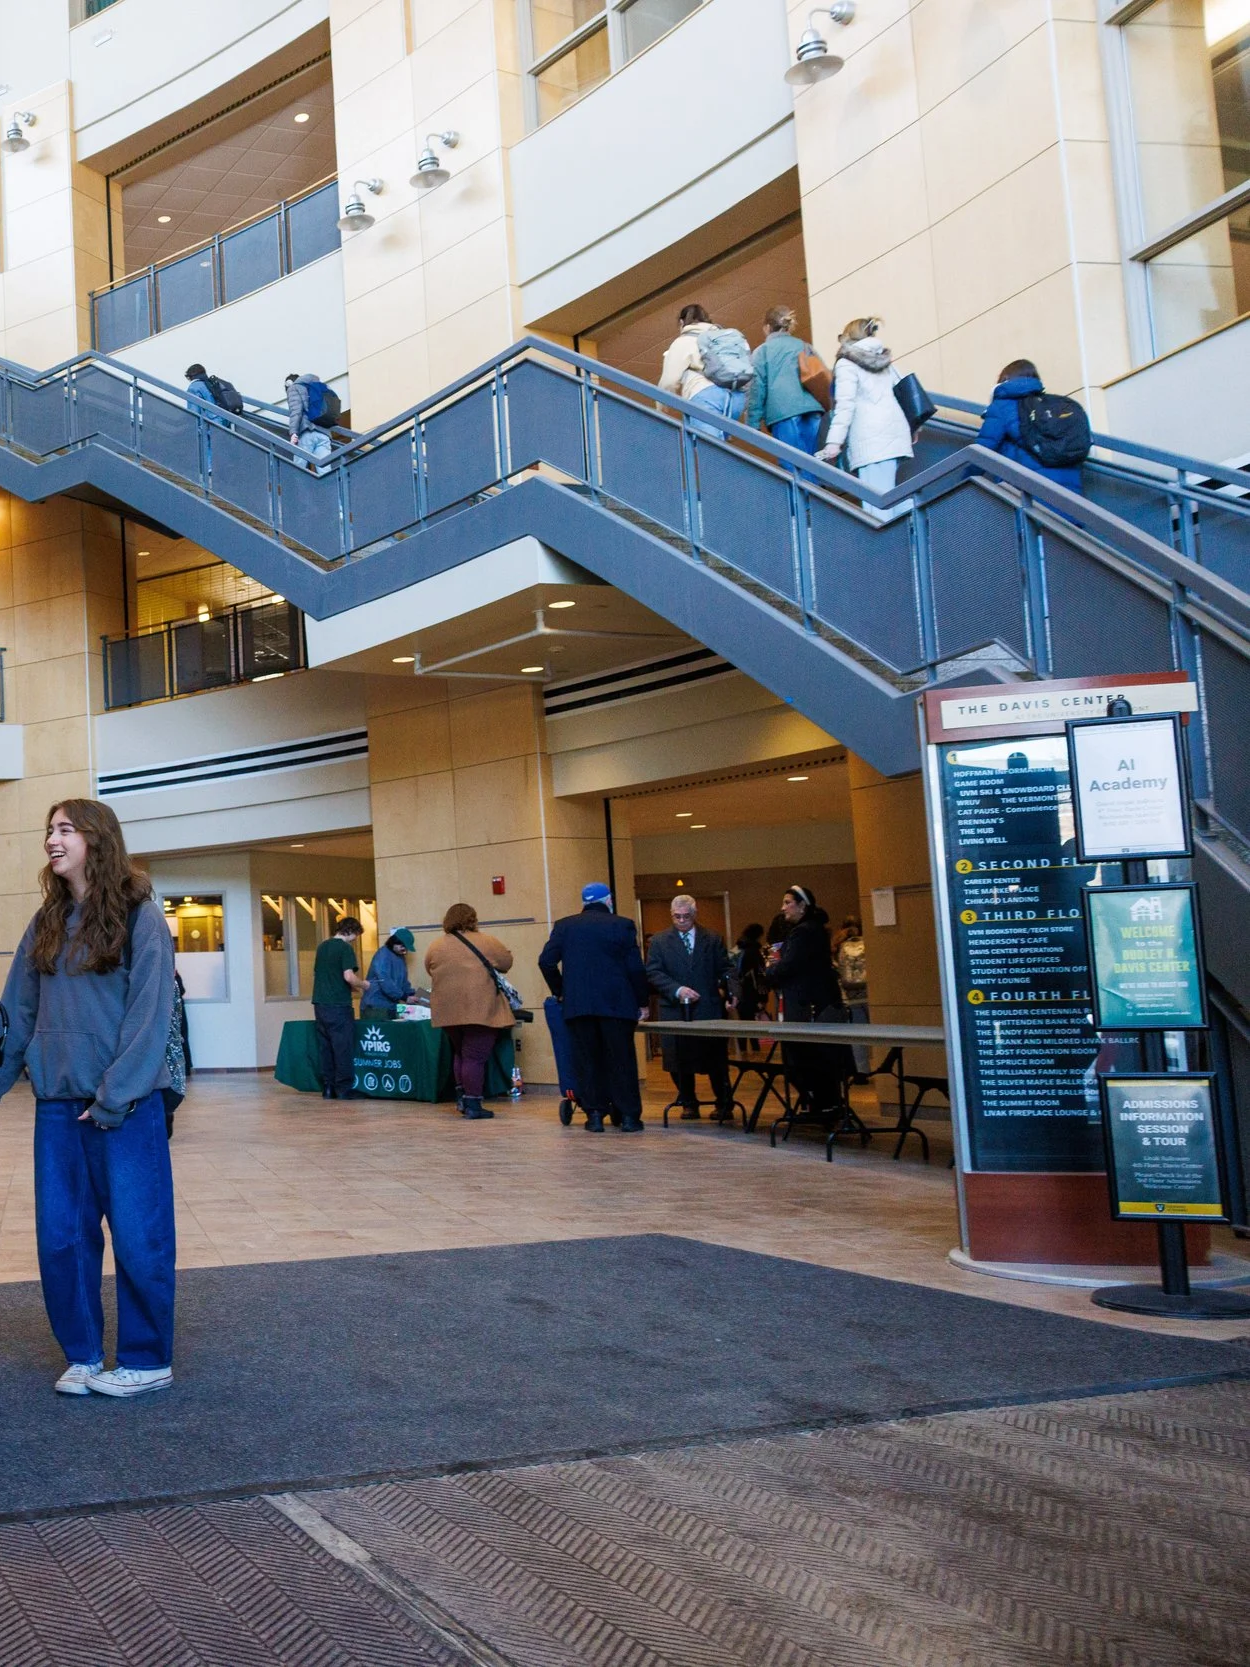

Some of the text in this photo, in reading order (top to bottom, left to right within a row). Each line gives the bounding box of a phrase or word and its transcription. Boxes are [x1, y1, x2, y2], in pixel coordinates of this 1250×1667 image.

[958, 704, 988, 715] THE
[999, 699, 1050, 712] DAVIS
[1118, 758, 1135, 771] AI
[954, 770, 993, 778] HOFFMAN
[954, 780, 978, 788] GAME
[1090, 777, 1168, 792] Academy
[1002, 785, 1055, 794] SNOWBOARD
[1018, 795, 1058, 803] VERMONT
[957, 808, 973, 816] CAT
[974, 807, 1000, 815] PAUSE
[1006, 804, 1058, 814] Convenience
[958, 818, 1004, 826] BRENNAN'S
[978, 858, 1051, 871] SECOND
[1002, 896, 1040, 904] LANDING
[982, 910, 1037, 921] THIRD
[1047, 908, 1080, 919] FLO
[1120, 925, 1176, 938] WELCOME
[968, 938, 1026, 946] HENDERSON'S
[1020, 946, 1064, 954] OPERATIONS
[970, 958, 1006, 966] STUDENT
[1026, 956, 1061, 964] OFFICES
[971, 967, 1008, 975] STUDENT
[1009, 966, 1070, 974] ORGANIZATION
[1114, 961, 1190, 974] DAVIS CENTER
[990, 991, 1061, 1001] FOURTH
[992, 1008, 1029, 1016] BOULDER
[1030, 1008, 1082, 1016] CENTENNIAL
[360, 1040, 391, 1052] VPIRG
[1016, 1048, 1070, 1056] FOUNDATION
[384, 1060, 402, 1068] JOBS
[996, 1058, 1028, 1066] SPRUCE
[996, 1068, 1037, 1076] WILLIAMS
[1038, 1068, 1068, 1076] FAMILY
[1123, 1100, 1198, 1109] ADMISSIONS
[1120, 1112, 1204, 1121] INFORMATION
[1137, 1125, 1189, 1134] SESSION
[1142, 1138, 1187, 1146] & TOUR
